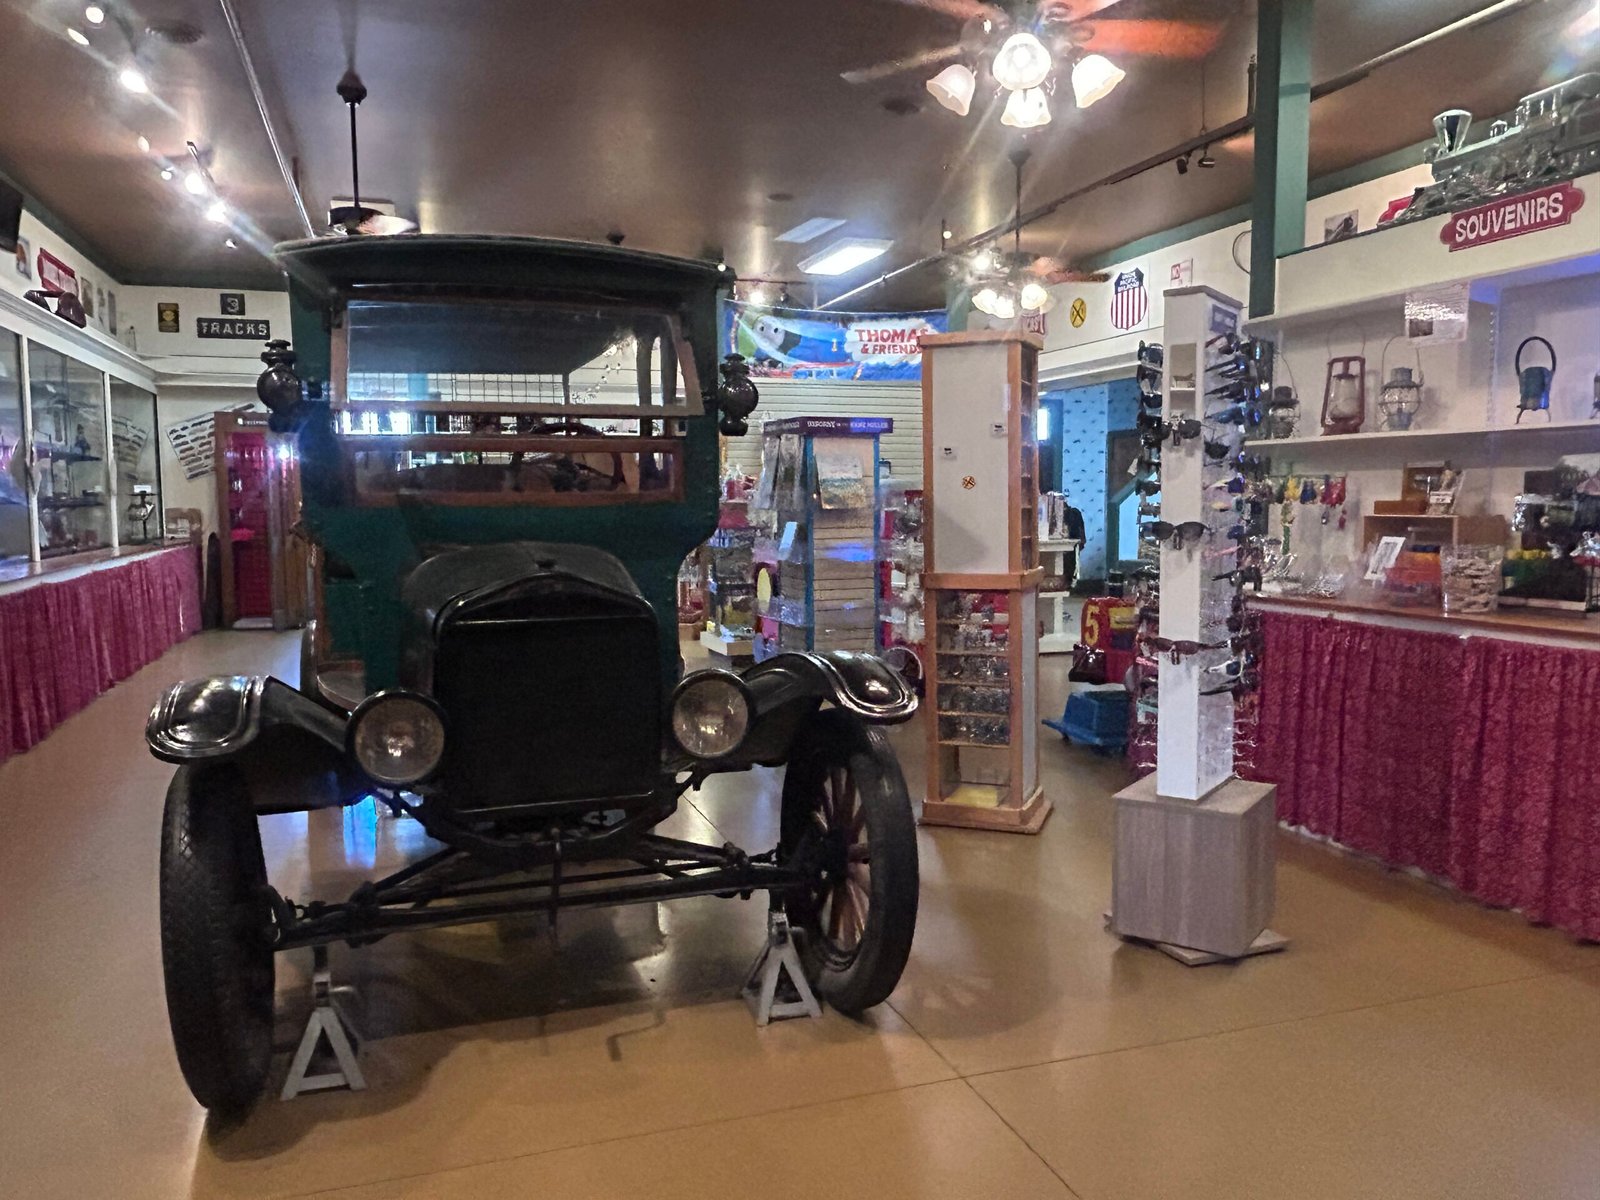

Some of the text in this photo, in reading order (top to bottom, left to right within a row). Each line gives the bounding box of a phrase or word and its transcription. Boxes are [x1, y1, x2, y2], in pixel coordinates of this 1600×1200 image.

[1455, 192, 1564, 242] SOUVENIRS
[226, 297, 240, 313] 3
[201, 322, 267, 336] TRACKS
[860, 343, 869, 354] &
[1084, 604, 1100, 647] 5
